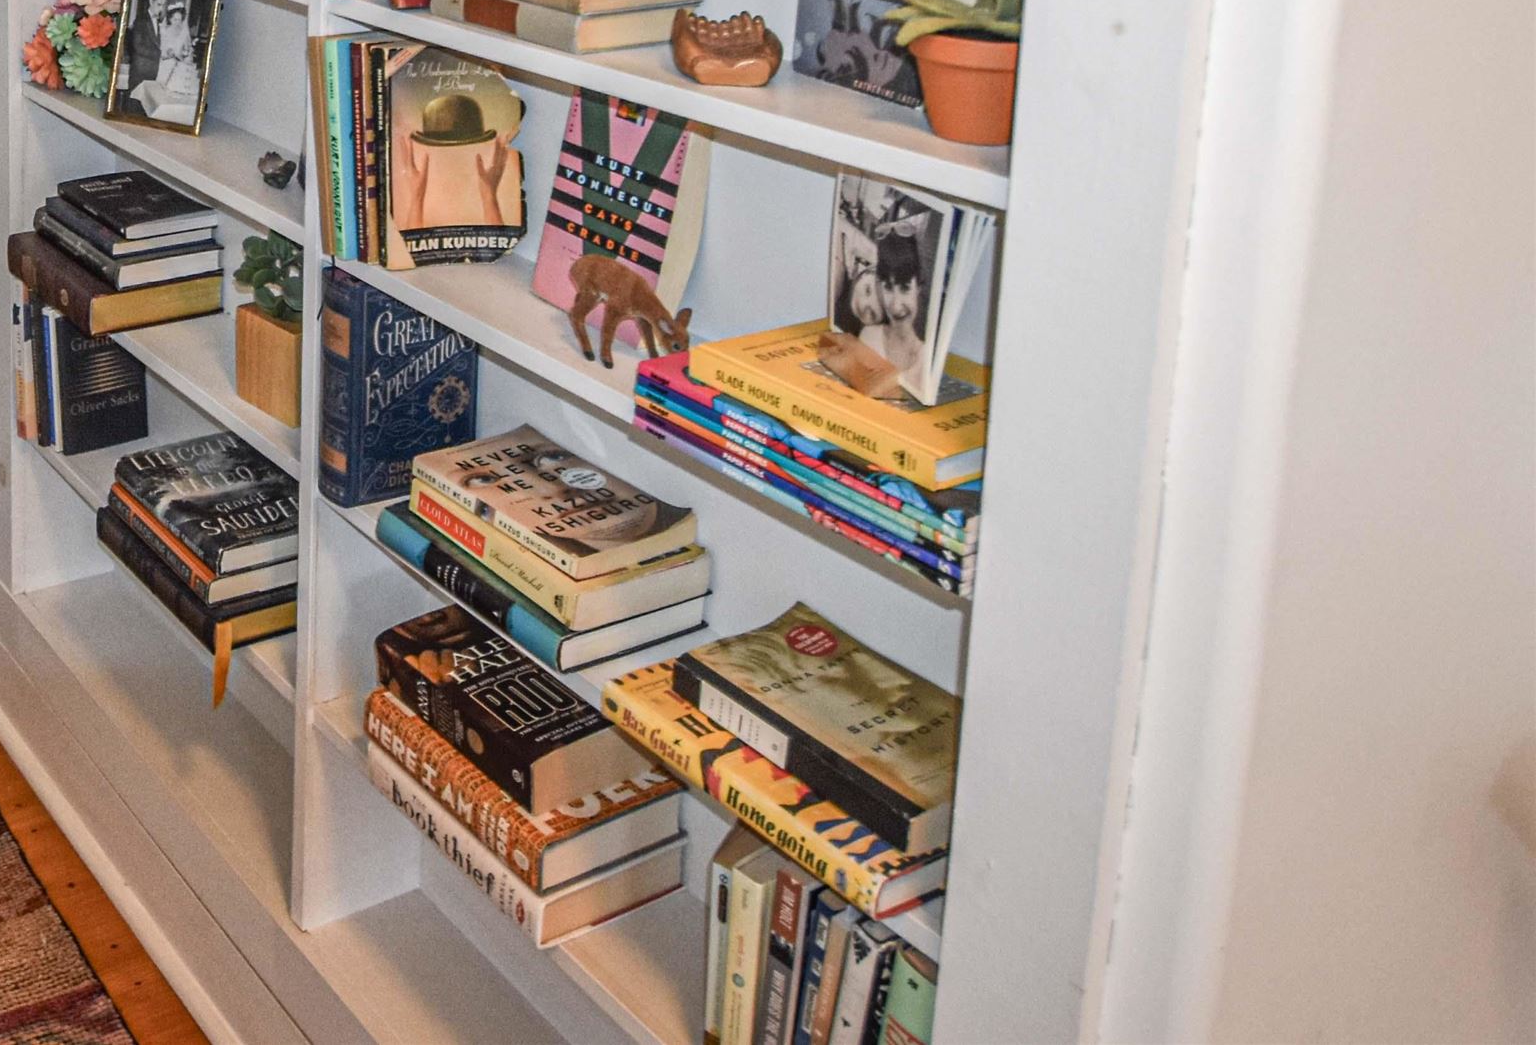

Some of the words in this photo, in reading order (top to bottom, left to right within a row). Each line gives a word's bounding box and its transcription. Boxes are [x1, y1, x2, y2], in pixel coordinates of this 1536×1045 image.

[376, 67, 384, 94] MILAN
[377, 95, 385, 132] KUNDERA
[330, 135, 340, 169] KURT
[595, 154, 646, 182] KURT
[332, 170, 343, 234] VONNEGUT
[565, 169, 667, 219] VONNEGUT
[584, 203, 634, 233] CAT'S
[406, 237, 440, 253] ILAN
[442, 236, 519, 250] KUNDERA
[566, 221, 642, 263] CRADLE
[374, 309, 437, 358] GREAT
[754, 344, 804, 363] DAVID
[69, 399, 107, 417] Oliver
[109, 389, 141, 408] Sacks
[714, 368, 747, 392] SLADE
[747, 384, 782, 410] HOUSE
[790, 403, 825, 429] DAVID
[825, 420, 880, 455] MITCHELL
[721, 428, 744, 443] PAPER
[129, 435, 240, 471] LINCOLN
[455, 443, 535, 471] NEVER
[722, 452, 745, 467] PAPER
[744, 463, 765, 479] GIRLS
[214, 490, 271, 513] GEORGE
[416, 467, 437, 486] NEVER
[437, 480, 451, 494] LET
[451, 488, 464, 501] ME
[463, 496, 473, 508] GO
[497, 478, 534, 495] ME
[532, 487, 615, 519] KAZUO
[199, 495, 300, 537] SAUNDE
[418, 496, 452, 528] CLOUD
[451, 518, 484, 550] ATLAS
[531, 493, 656, 537] ISHIGURO
[498, 518, 521, 540] KAZUO
[522, 534, 557, 562] ISHIGURO
[447, 652, 522, 685] HAL
[452, 637, 511, 667] ALE
[759, 670, 814, 694] DONNA
[469, 668, 580, 732] ROO
[846, 697, 921, 735] SECRET
[621, 707, 647, 738] Yaa
[649, 726, 691, 773] Gyasi
[871, 710, 953, 754] HISTORY
[368, 712, 418, 774] HERE
[421, 761, 439, 792] I
[441, 781, 473, 825] AM
[392, 778, 441, 846] book
[443, 833, 496, 896] thief
[725, 785, 830, 880] Homegoing
[781, 886, 797, 906] JIM
[778, 903, 795, 931] HOLT
[769, 969, 786, 990] WHY
[766, 989, 784, 1015] DOES
[764, 1014, 781, 1036] THE
